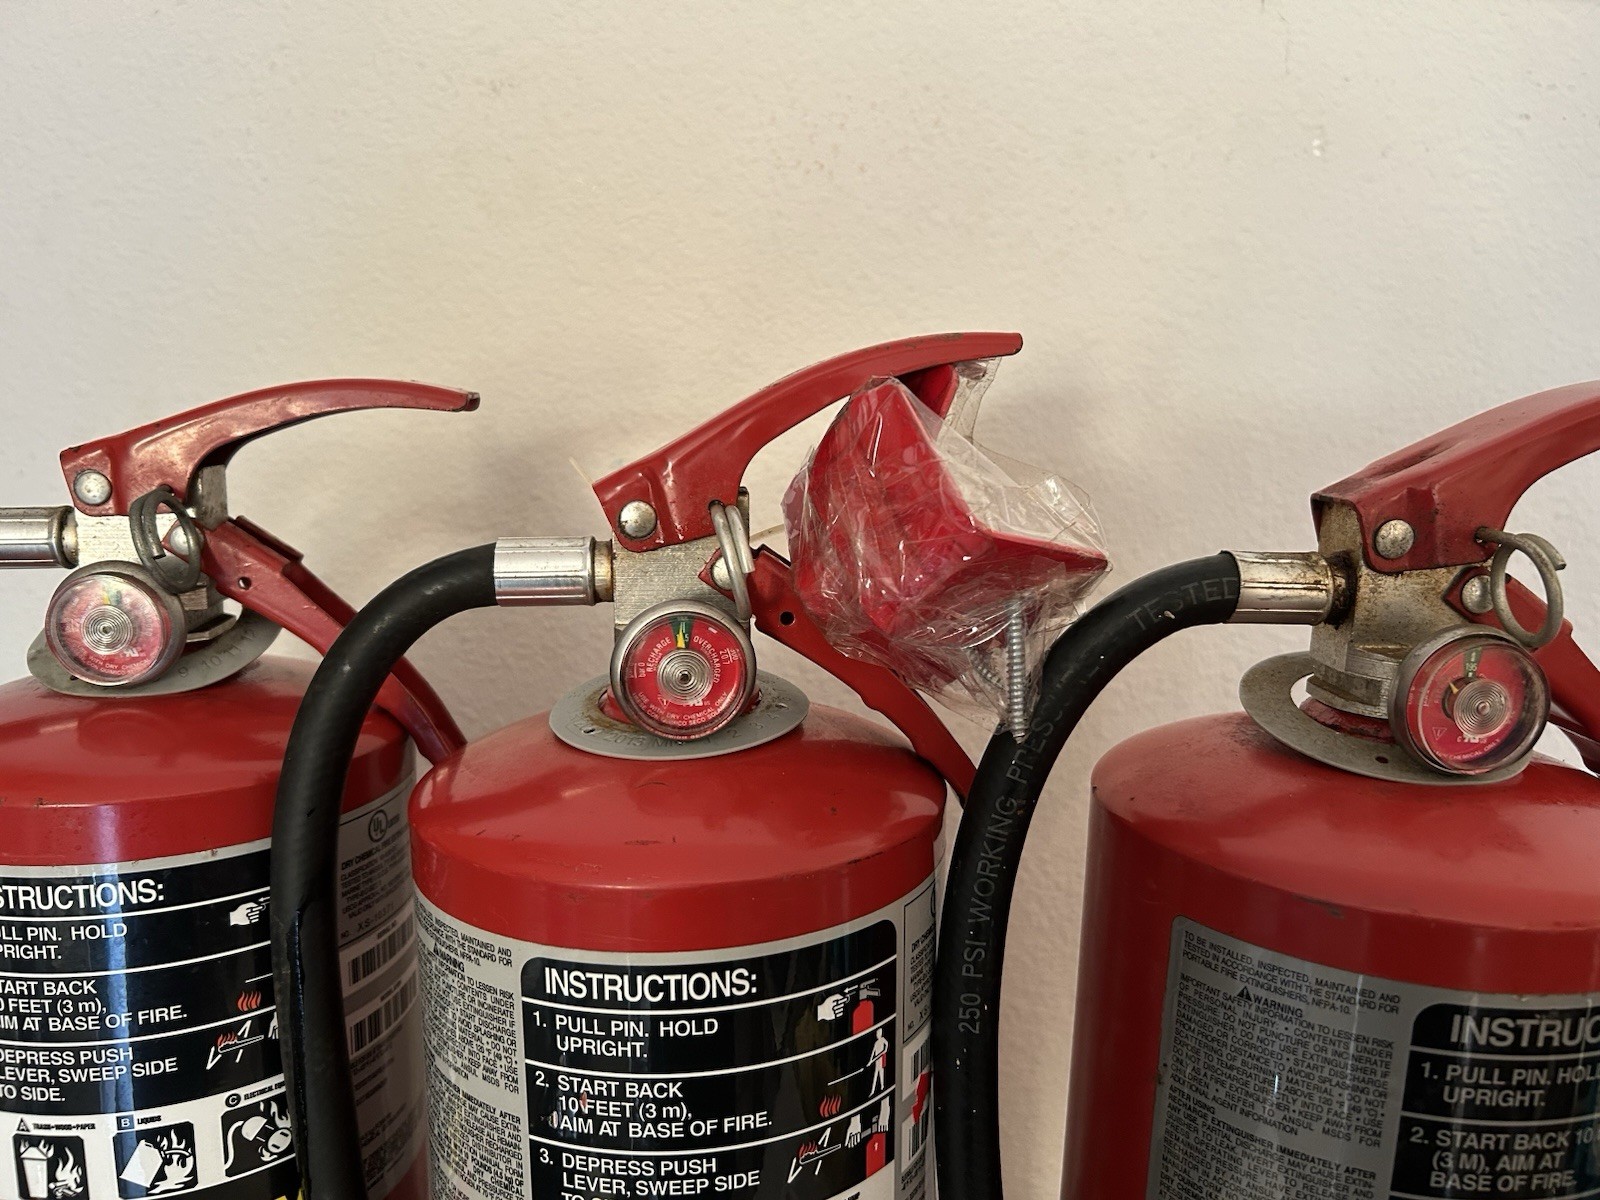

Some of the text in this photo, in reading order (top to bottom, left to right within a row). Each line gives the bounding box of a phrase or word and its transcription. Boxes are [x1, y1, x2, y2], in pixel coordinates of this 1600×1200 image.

[646, 637, 672, 672] RECHARGE
[693, 635, 721, 684] OVERCHARGED
[638, 692, 650, 703] USE
[682, 705, 715, 720] CHEMICAL
[715, 692, 728, 707] ONLY
[967, 795, 1018, 923] WORKING
[0, 878, 165, 910] TRUCTIONS:
[0, 923, 128, 941] LL PIN. HOLD
[467, 944, 512, 967] STANDARD FOR
[498, 946, 512, 957] AND
[961, 940, 987, 978] PSI
[1183, 950, 1219, 972] PORTABLE
[1220, 966, 1238, 980] FIRE
[1184, 939, 1400, 1014] TESTED IN ACCORDANCE WITH THE FOR
[1185, 930, 1194, 941] TO
[1197, 936, 1206, 947] BE
[1378, 993, 1400, 1004] AND
[0, 980, 97, 996] ART BACK
[457, 980, 515, 1011] CONTENTS UNDER
[475, 981, 515, 1000] LESSEN RISK
[545, 967, 757, 1002] INSTRUCTIONS:
[8, 999, 52, 1014] FEET
[57, 999, 74, 1017] (3
[79, 998, 107, 1014] m),
[958, 993, 981, 1034] 250
[1180, 972, 1394, 1050] IMPORTANT INFORMATION TO RISK
[1253, 993, 1303, 1018] WARNING
[0, 1004, 187, 1032] IM AT BASE OF FIRE.
[479, 1017, 516, 1039] DISCHARGE
[533, 1011, 718, 1037] 1. PULL PIN. HOLD
[1179, 982, 1392, 1060] OF PERSONAL CONTENTS UNDER
[506, 1037, 516, 1047] OR
[1450, 1014, 1600, 1047] INSTRUC
[0, 1047, 133, 1066] EPRESS PUSH
[502, 1045, 517, 1057] NOT
[556, 1035, 648, 1058] UPRIGHT.
[1313, 1044, 1328, 1055] OR
[58, 1065, 127, 1083] SWEEP
[132, 1057, 178, 1078] SIDE
[500, 1071, 519, 1085] FROM
[1287, 1066, 1315, 1080] AVOID
[1293, 1058, 1325, 1074] START
[1421, 1062, 1600, 1086] 1. PULL PIN. HOL
[21, 1086, 66, 1102] SIDE.
[244, 1085, 274, 1100] ELECTRICAL
[481, 1072, 519, 1094] MSDS FOR
[535, 1071, 683, 1099] 2. START BACK
[1286, 1075, 1335, 1097] MATERIAL
[559, 1095, 692, 1122] 10 FEET (3 m),
[1443, 1086, 1545, 1107] UPRIGHT.
[499, 1110, 521, 1124] AFTER
[560, 1111, 772, 1139] AIM AT BASE OF FIRE.
[508, 1131, 521, 1143] AND
[1281, 1114, 1380, 1147] ANSUL MSDS FOR
[1410, 1126, 1429, 1145] 2.
[1436, 1129, 1509, 1150] START
[1514, 1130, 1571, 1150] BACK
[1576, 1127, 1593, 1145] 10
[505, 1164, 524, 1179] FORM
[539, 1148, 717, 1176] 3. DEPRESS PUSH
[1276, 1144, 1376, 1180] IMMEDIATELY AFTER
[1432, 1150, 1453, 1171] (3
[1495, 1154, 1534, 1172] AIM
[1539, 1151, 1565, 1169] AT
[562, 1172, 631, 1197] LEVER,
[635, 1179, 709, 1196] SWEEP
[714, 1170, 760, 1192] SIDE
[1430, 1171, 1493, 1192] BASE
[1497, 1174, 1526, 1192] OF
